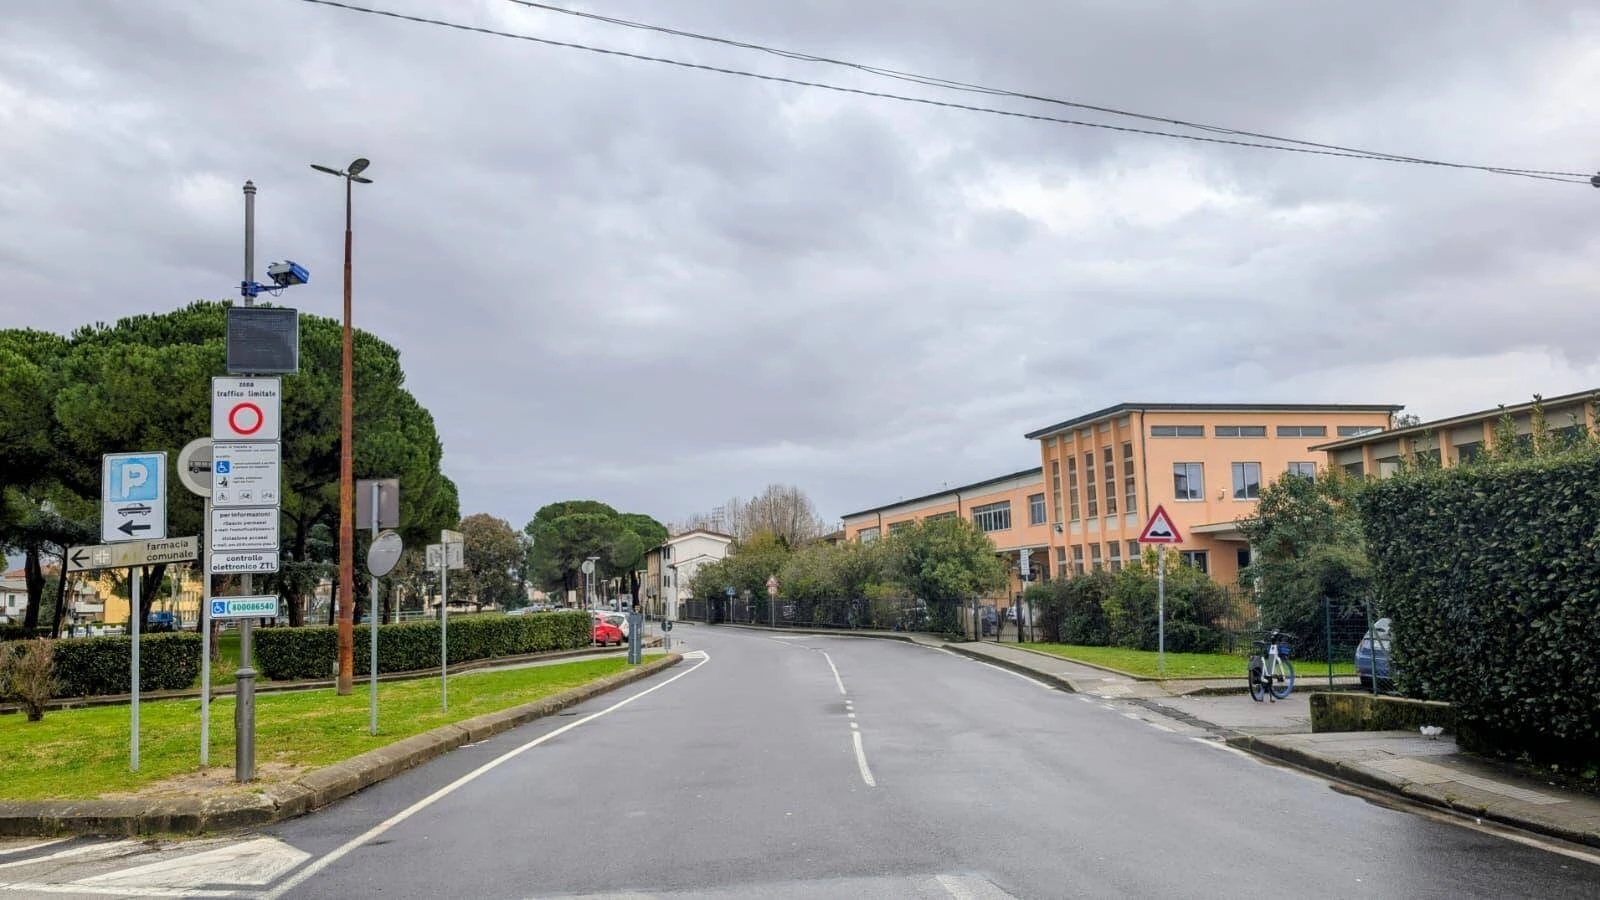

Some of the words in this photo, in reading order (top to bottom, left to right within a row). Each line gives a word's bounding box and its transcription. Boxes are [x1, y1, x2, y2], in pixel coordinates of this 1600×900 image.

[121, 462, 149, 499] P
[147, 540, 189, 551] farmacia
[146, 550, 194, 562] comunale
[226, 554, 263, 562] controllo
[212, 563, 258, 571] elettronico
[259, 562, 275, 570] ZTL
